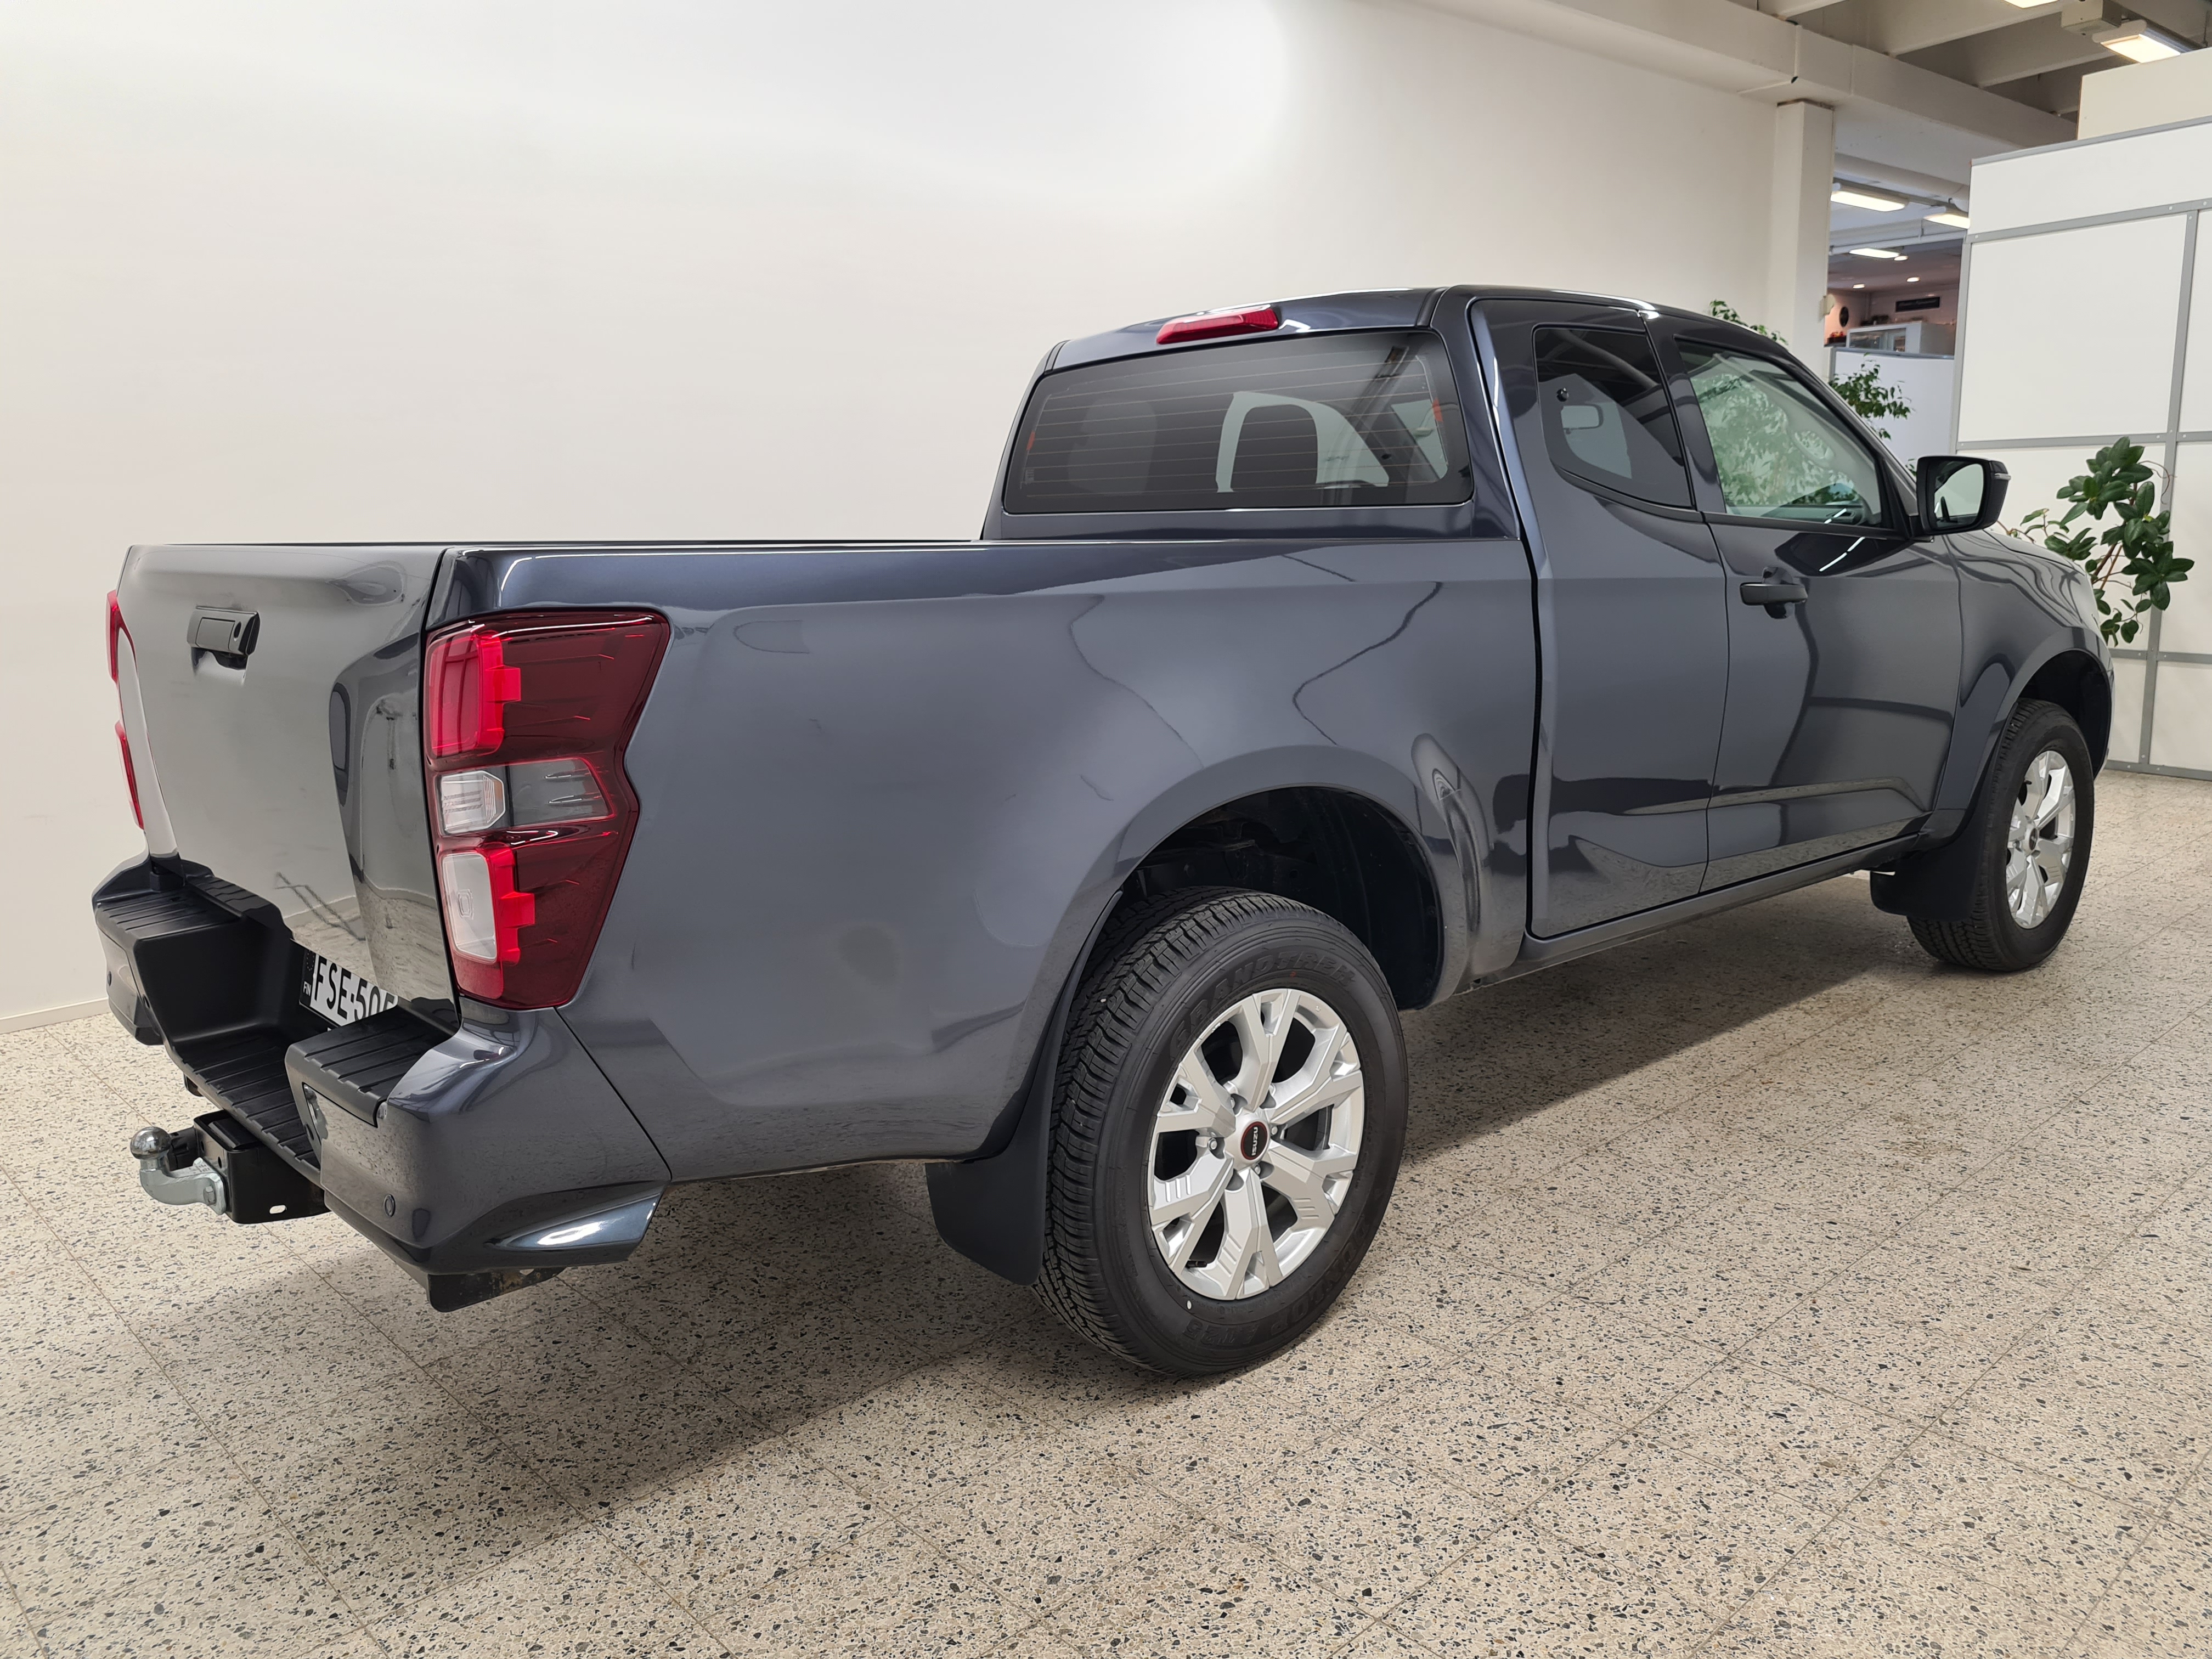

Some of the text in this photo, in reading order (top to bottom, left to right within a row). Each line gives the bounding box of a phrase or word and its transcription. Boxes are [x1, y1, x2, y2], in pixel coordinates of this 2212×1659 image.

[303, 981, 312, 997] FIN
[1170, 951, 1356, 1057] GRANDTREK
[1270, 1217, 1370, 1336] DUNLOP
